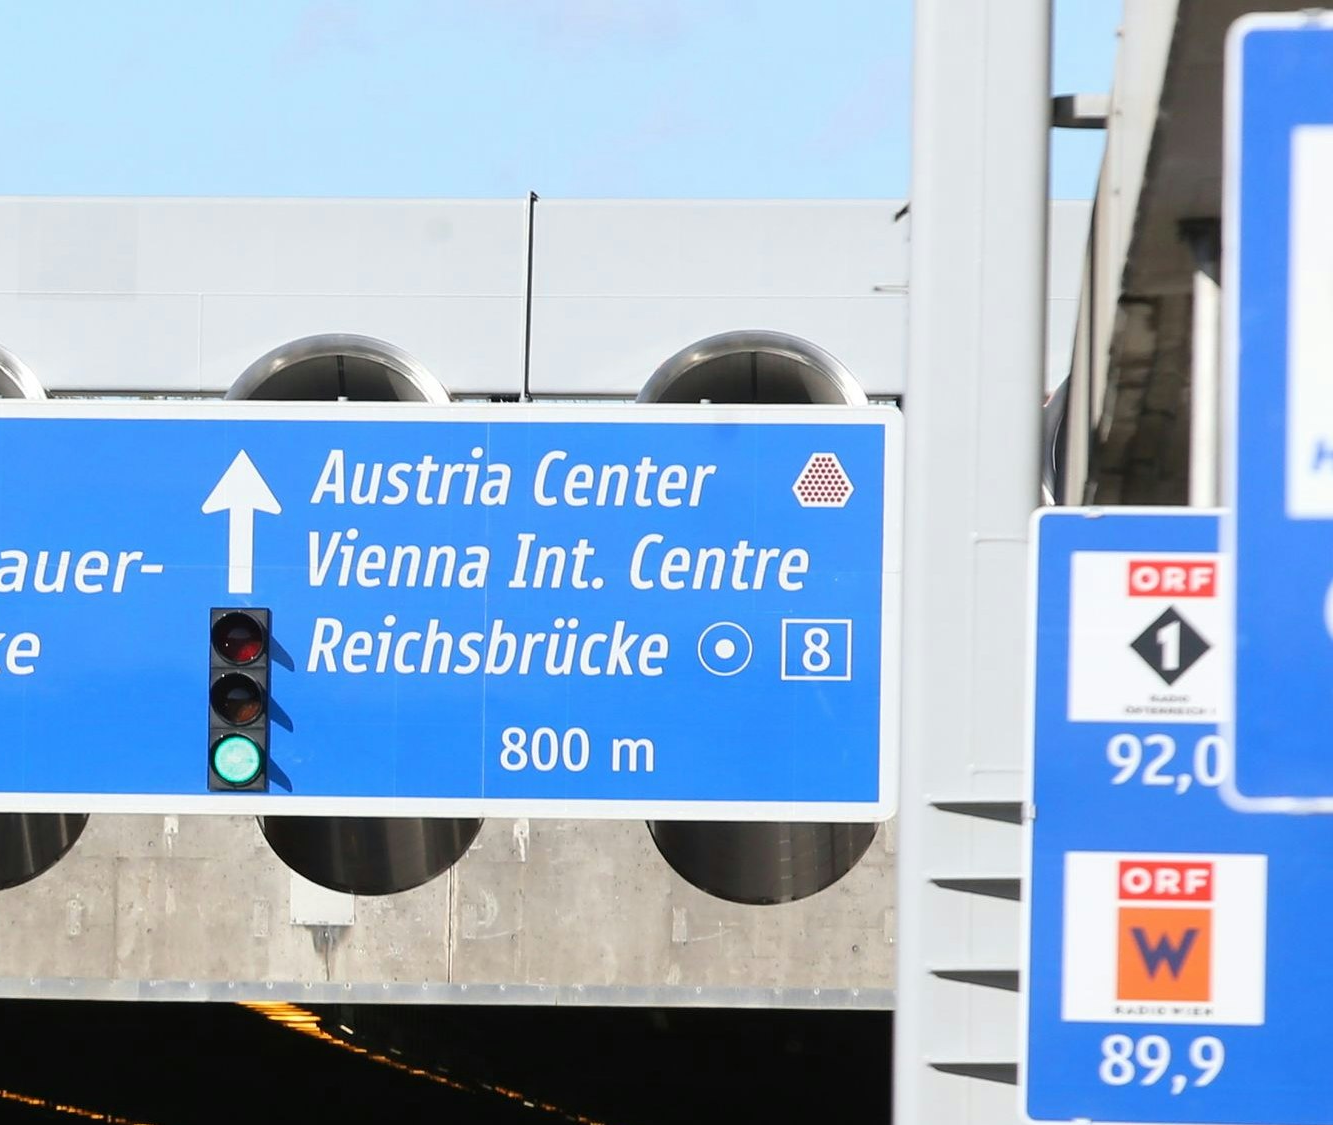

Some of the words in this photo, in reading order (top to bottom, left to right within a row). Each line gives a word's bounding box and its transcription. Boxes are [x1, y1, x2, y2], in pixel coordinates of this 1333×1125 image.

[310, 446, 511, 506] Austria
[533, 450, 717, 507] Center
[308, 528, 490, 589] Vienna
[508, 533, 604, 590] Int.
[630, 533, 809, 591] Centre
[1131, 567, 1214, 593] ORF
[307, 615, 669, 676] Reichsbrücke
[802, 629, 831, 672] 8
[1156, 620, 1181, 671] 1
[500, 727, 590, 772] 800
[612, 738, 654, 772] m
[1105, 732, 1228, 797] 92,0
[1121, 868, 1211, 895] ORF
[1128, 927, 1201, 981] W
[1099, 1034, 1226, 1095] 89,9
